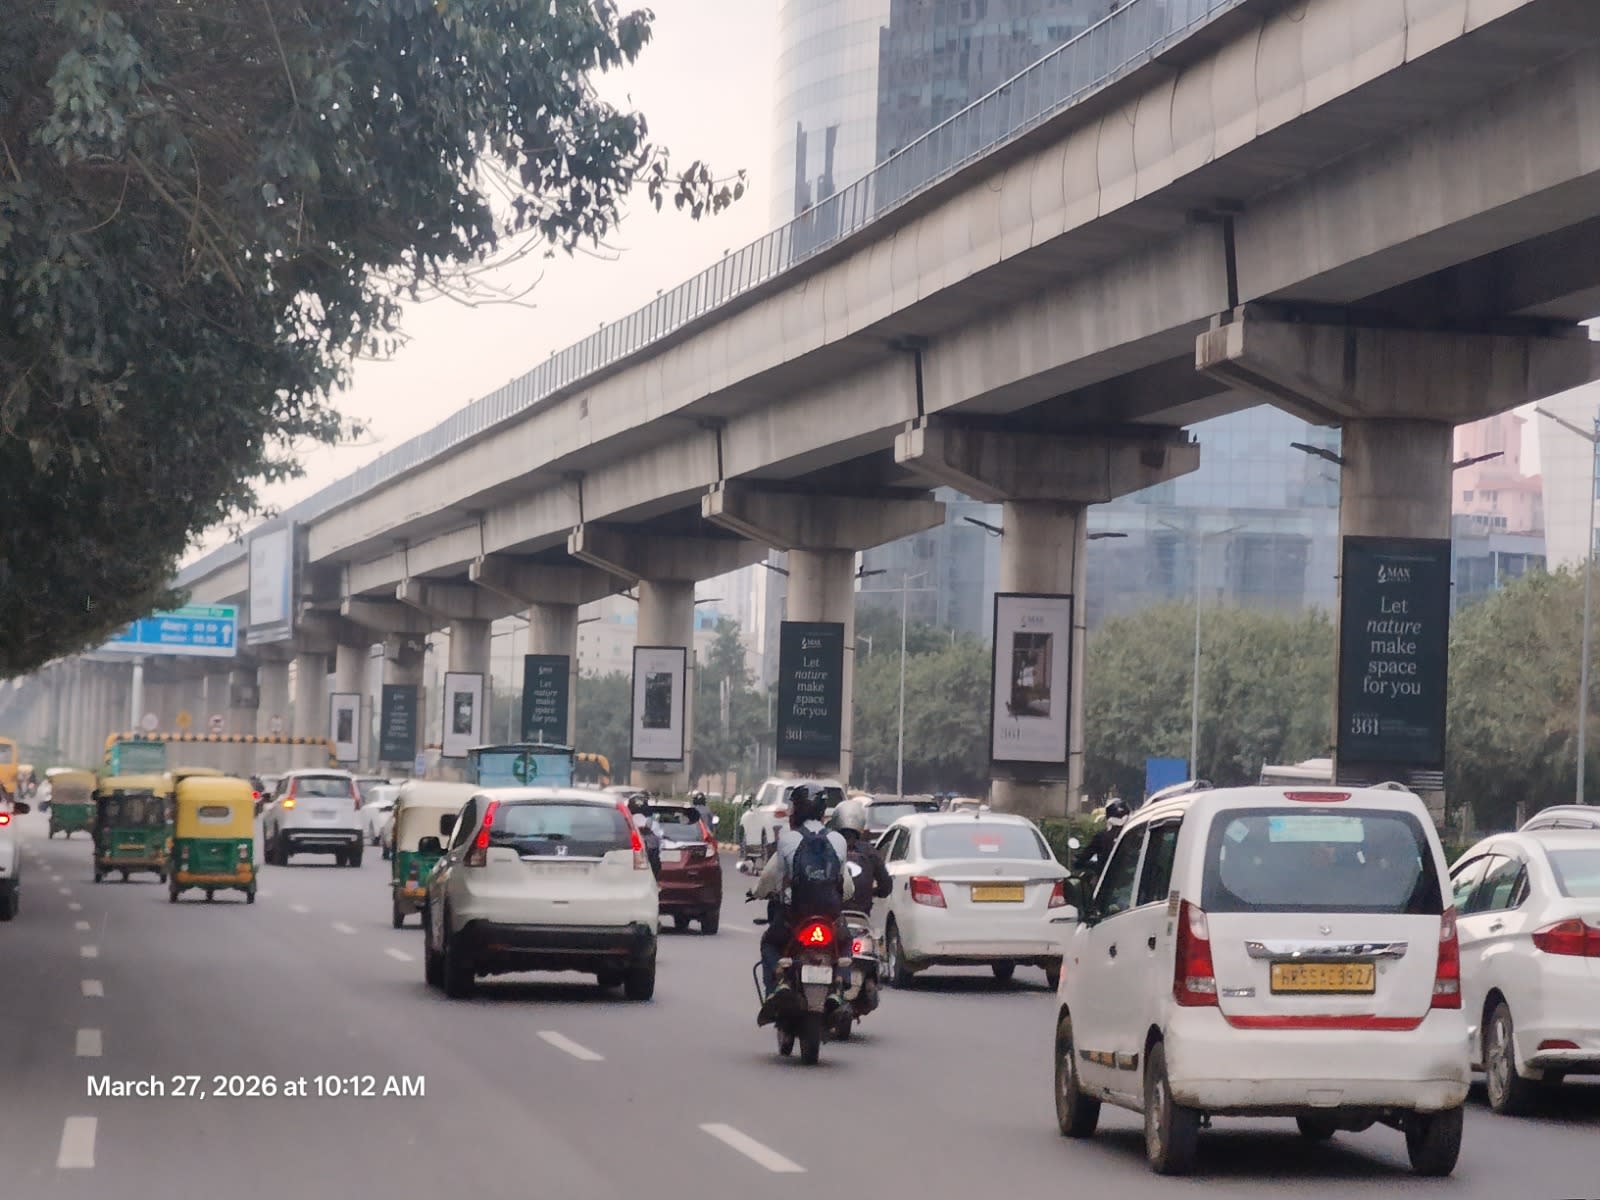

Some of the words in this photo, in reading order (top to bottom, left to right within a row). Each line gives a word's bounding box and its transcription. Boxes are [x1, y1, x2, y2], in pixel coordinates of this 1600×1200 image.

[1387, 567, 1411, 578] MAX
[1381, 595, 1409, 614] Let
[1366, 619, 1423, 635] nature
[1370, 637, 1417, 655] make
[803, 656, 820, 668] Let
[1368, 660, 1418, 678] space
[794, 670, 829, 681] nature
[797, 682, 825, 692] make
[1363, 676, 1388, 695] for
[1390, 681, 1422, 699] you
[795, 694, 825, 705] space
[792, 705, 808, 716] for
[808, 707, 828, 719] you
[1351, 717, 1379, 736] 361
